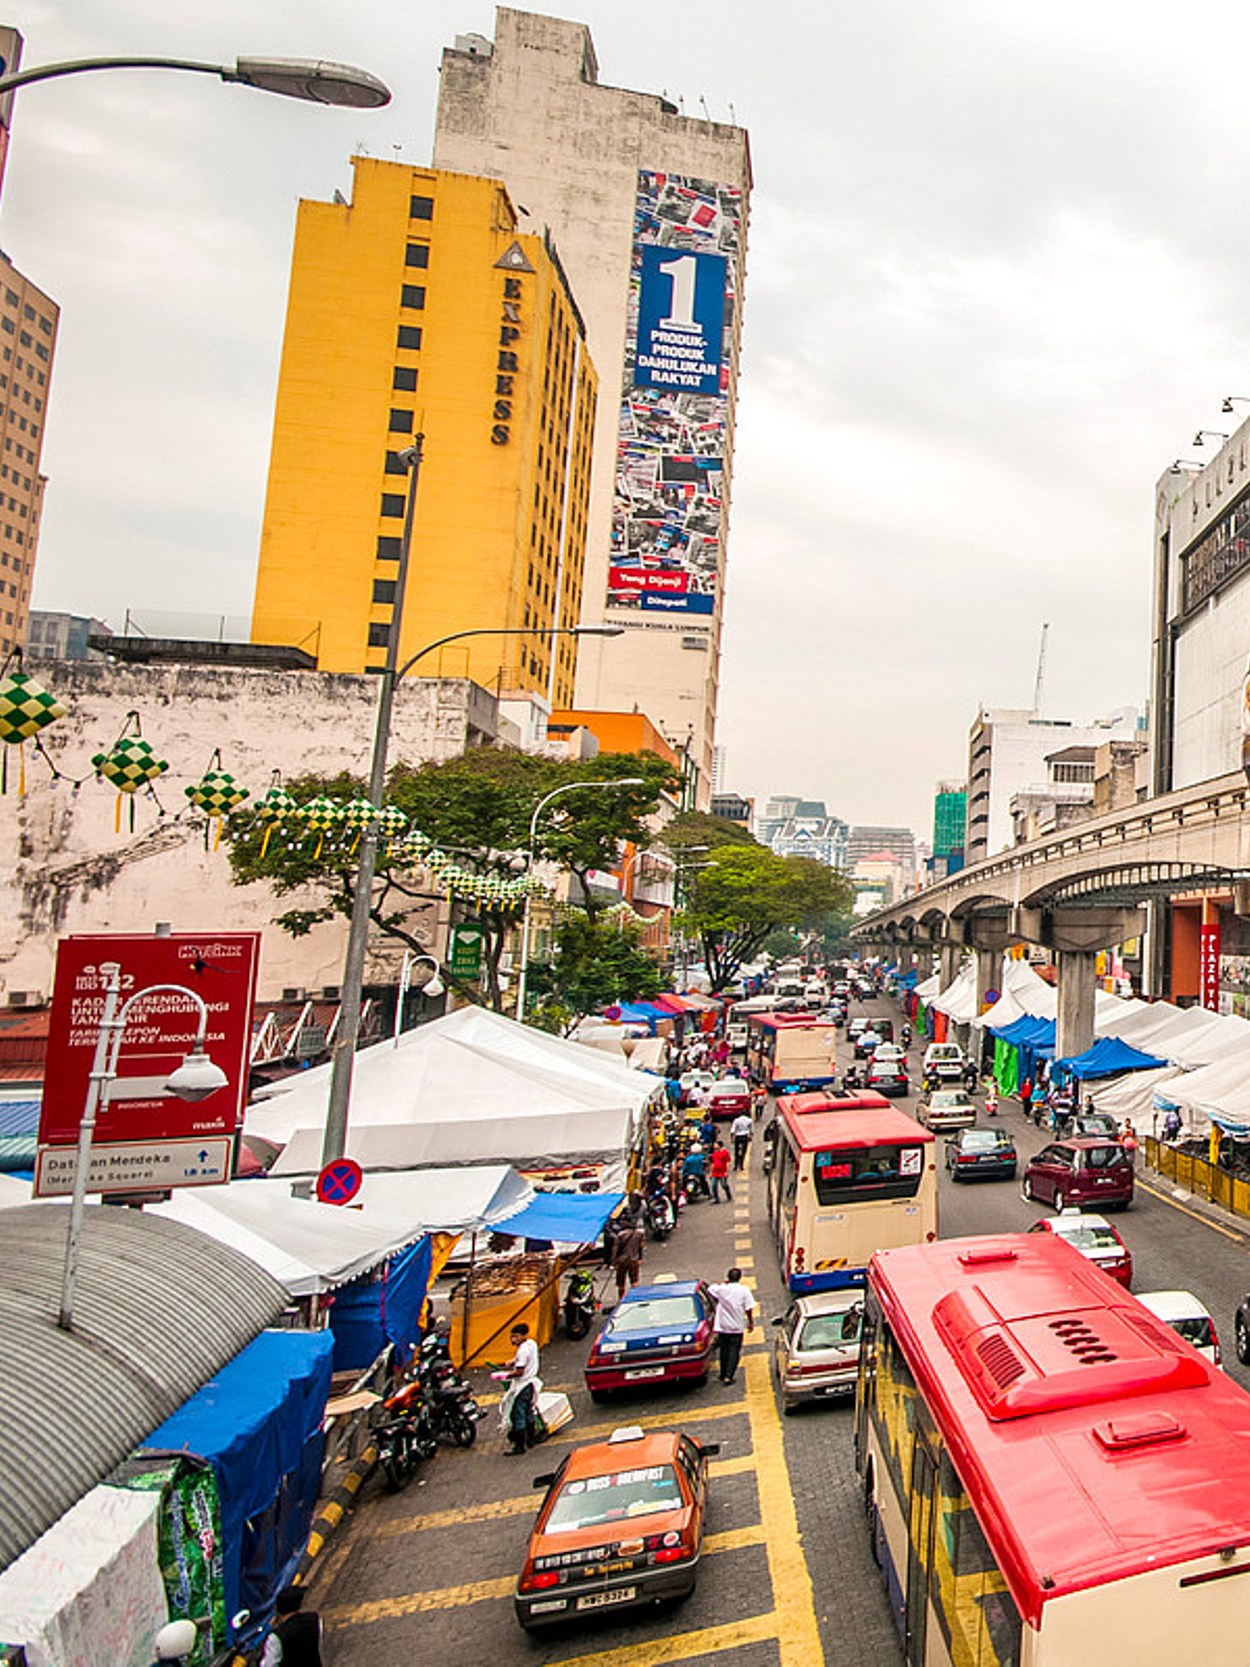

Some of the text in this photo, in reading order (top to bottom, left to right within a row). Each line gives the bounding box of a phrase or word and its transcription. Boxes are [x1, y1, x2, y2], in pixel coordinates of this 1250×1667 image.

[659, 255, 702, 333] 1
[490, 277, 522, 446] EXPRESS
[652, 343, 705, 361] PRODUK
[638, 355, 717, 376] DAHULUKAN
[650, 369, 703, 387] RAKYAT
[1206, 934, 1217, 984] PLAZA
[109, 1154, 171, 1167] Merdeka
